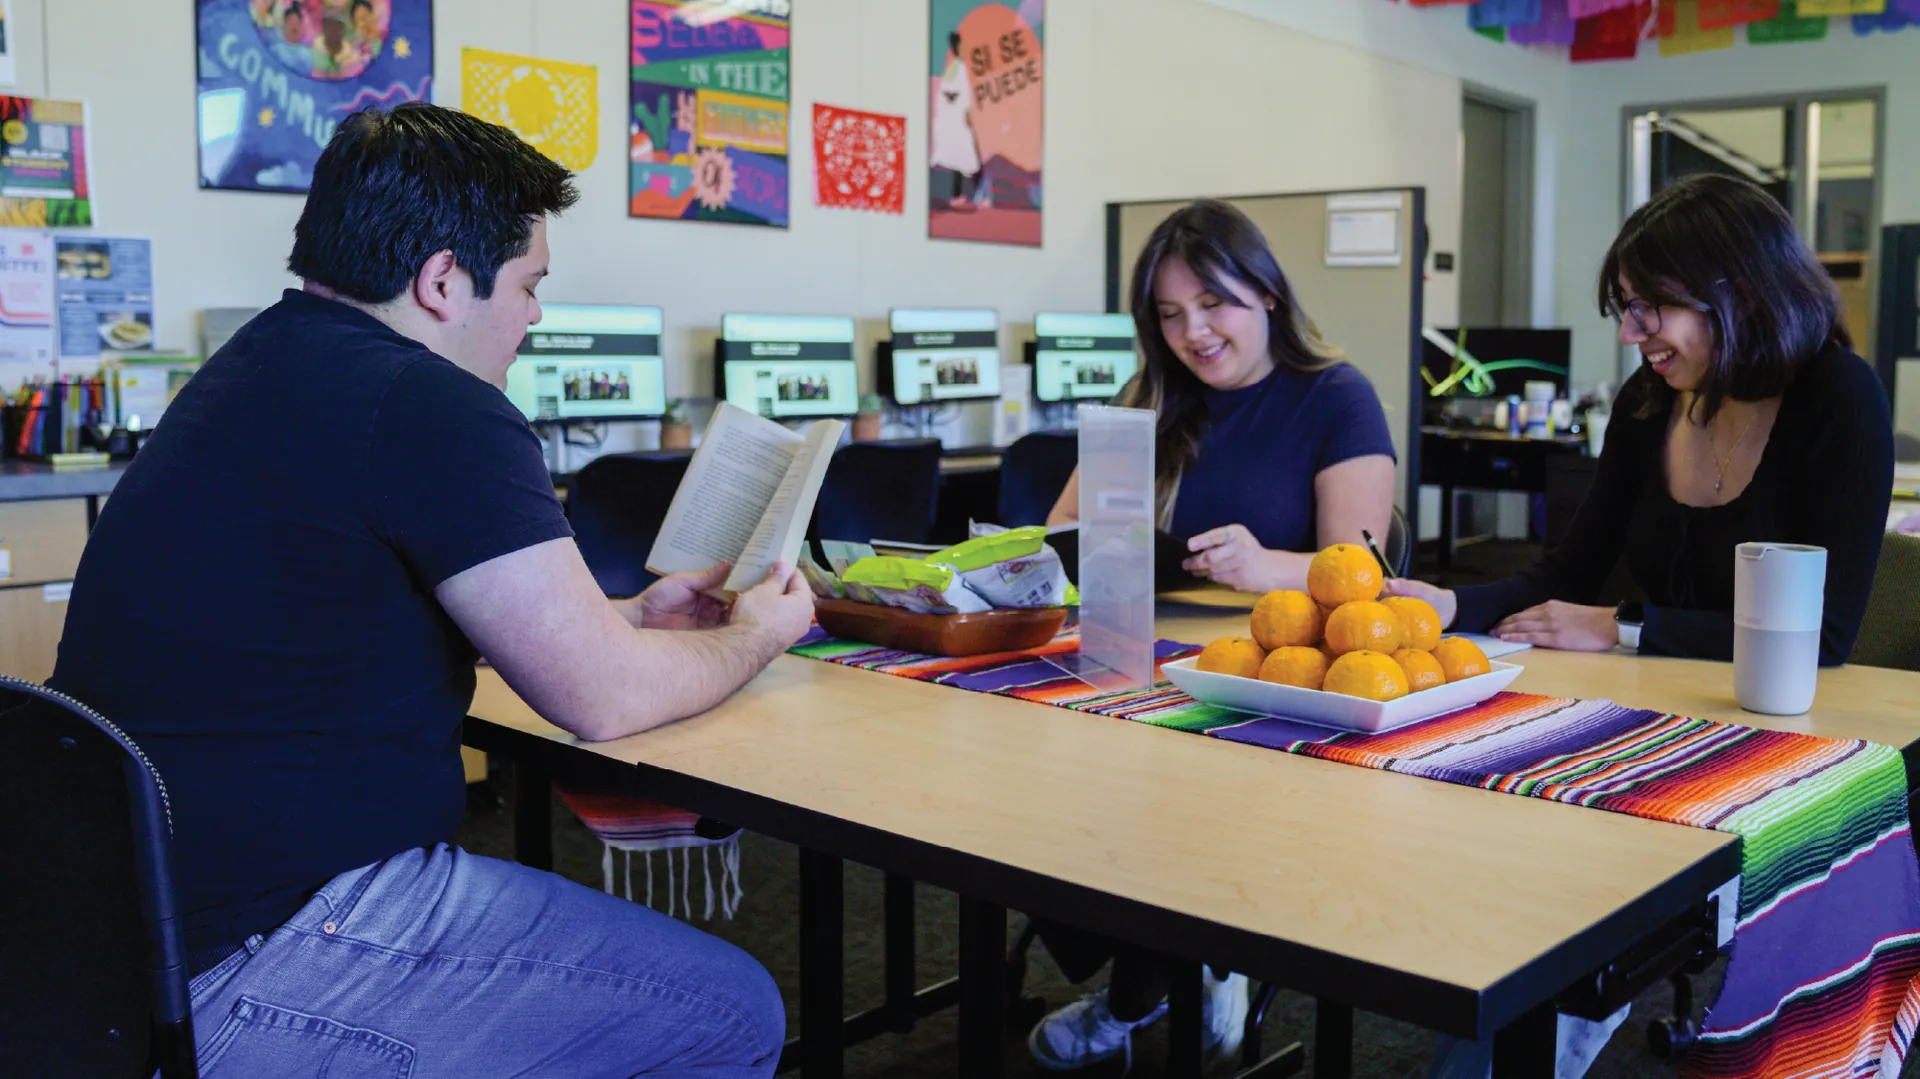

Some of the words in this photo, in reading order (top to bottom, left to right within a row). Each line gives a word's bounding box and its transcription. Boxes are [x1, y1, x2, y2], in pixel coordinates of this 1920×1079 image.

[971, 43, 994, 77] SI
[998, 29, 1029, 64] SE
[689, 63, 710, 85] IN
[714, 61, 787, 98] THE
[974, 59, 1041, 112] PUEDE
